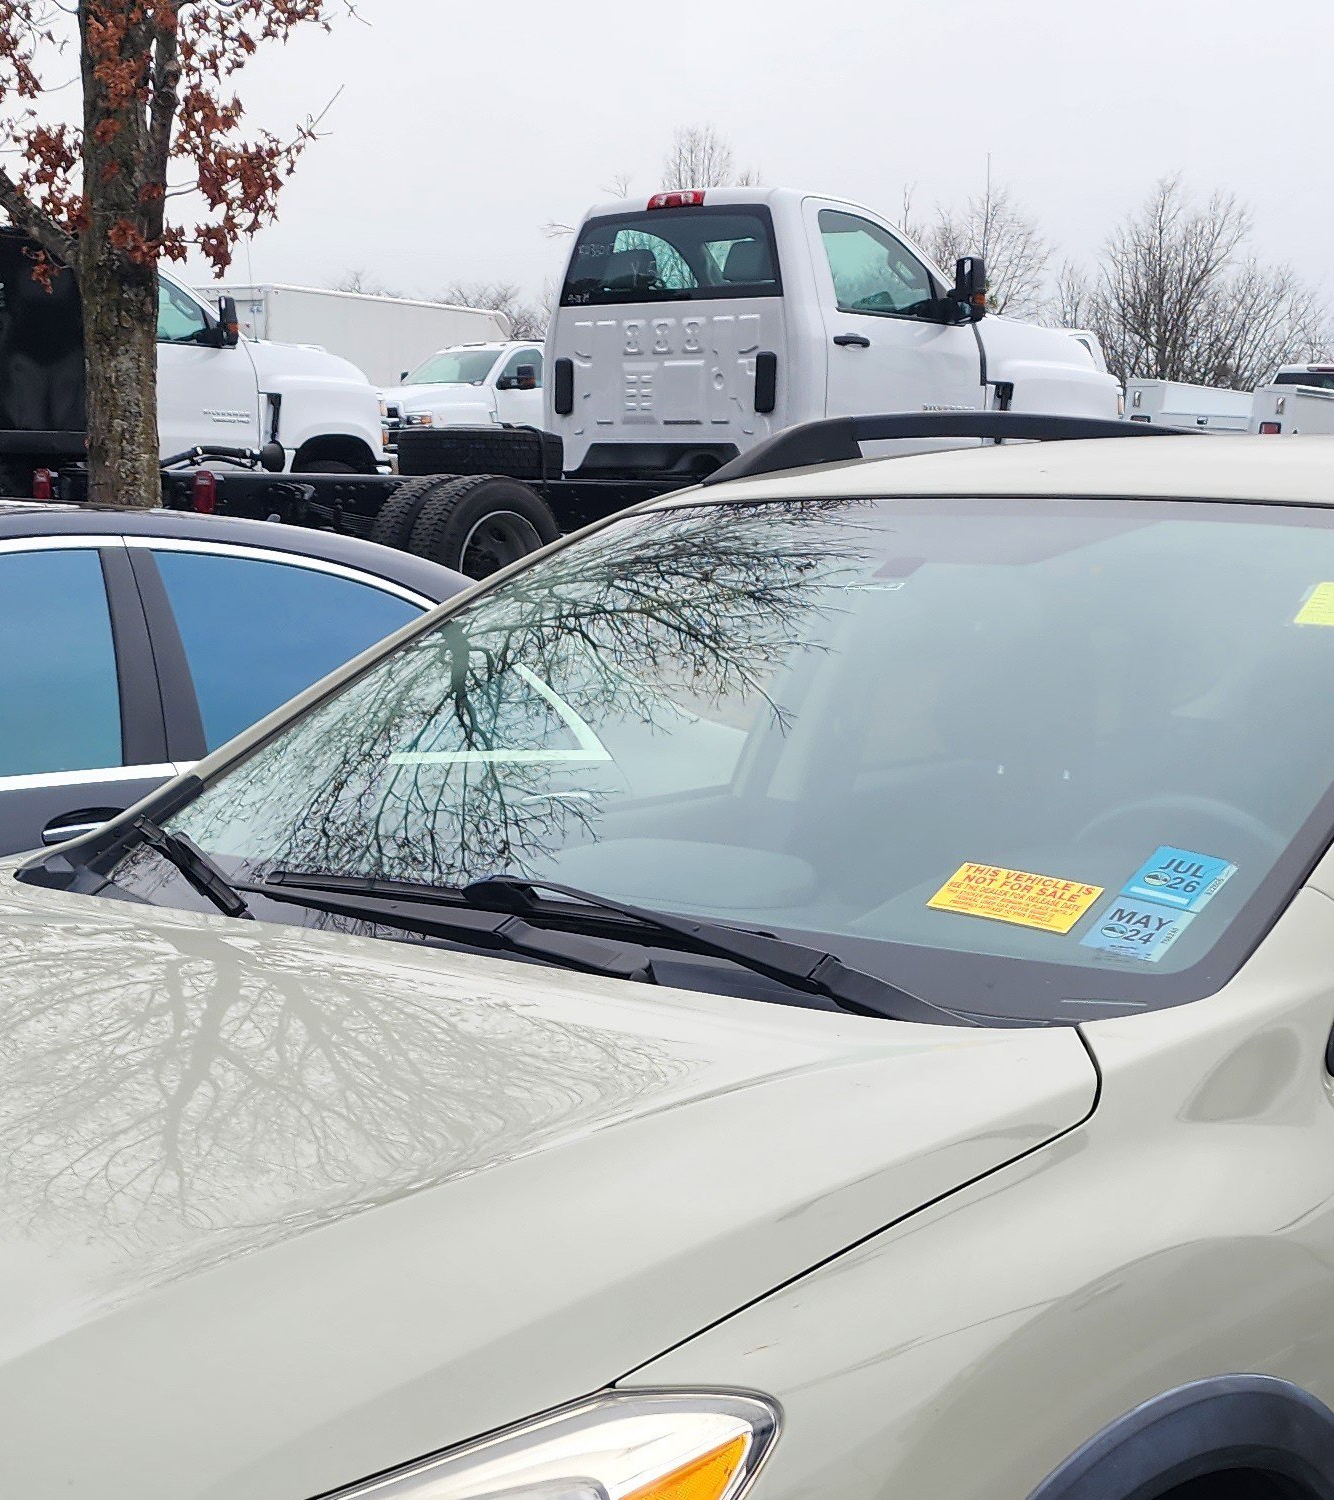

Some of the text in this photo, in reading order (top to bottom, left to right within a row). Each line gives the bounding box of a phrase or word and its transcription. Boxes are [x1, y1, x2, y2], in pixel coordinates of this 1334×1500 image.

[966, 865, 1095, 895] THIS VEHICLE IS
[1158, 858, 1205, 879] JUL
[963, 875, 997, 886] NOT
[998, 881, 1034, 893] FOR
[1036, 888, 1081, 902] SALE
[1167, 876, 1200, 893] 26
[979, 886, 1009, 896] DEALER
[1009, 891, 1026, 900] FOR
[1026, 895, 1060, 906] RELEASE
[1060, 902, 1082, 911] DATE
[1109, 908, 1174, 931] MAY
[1123, 928, 1155, 945] 24
